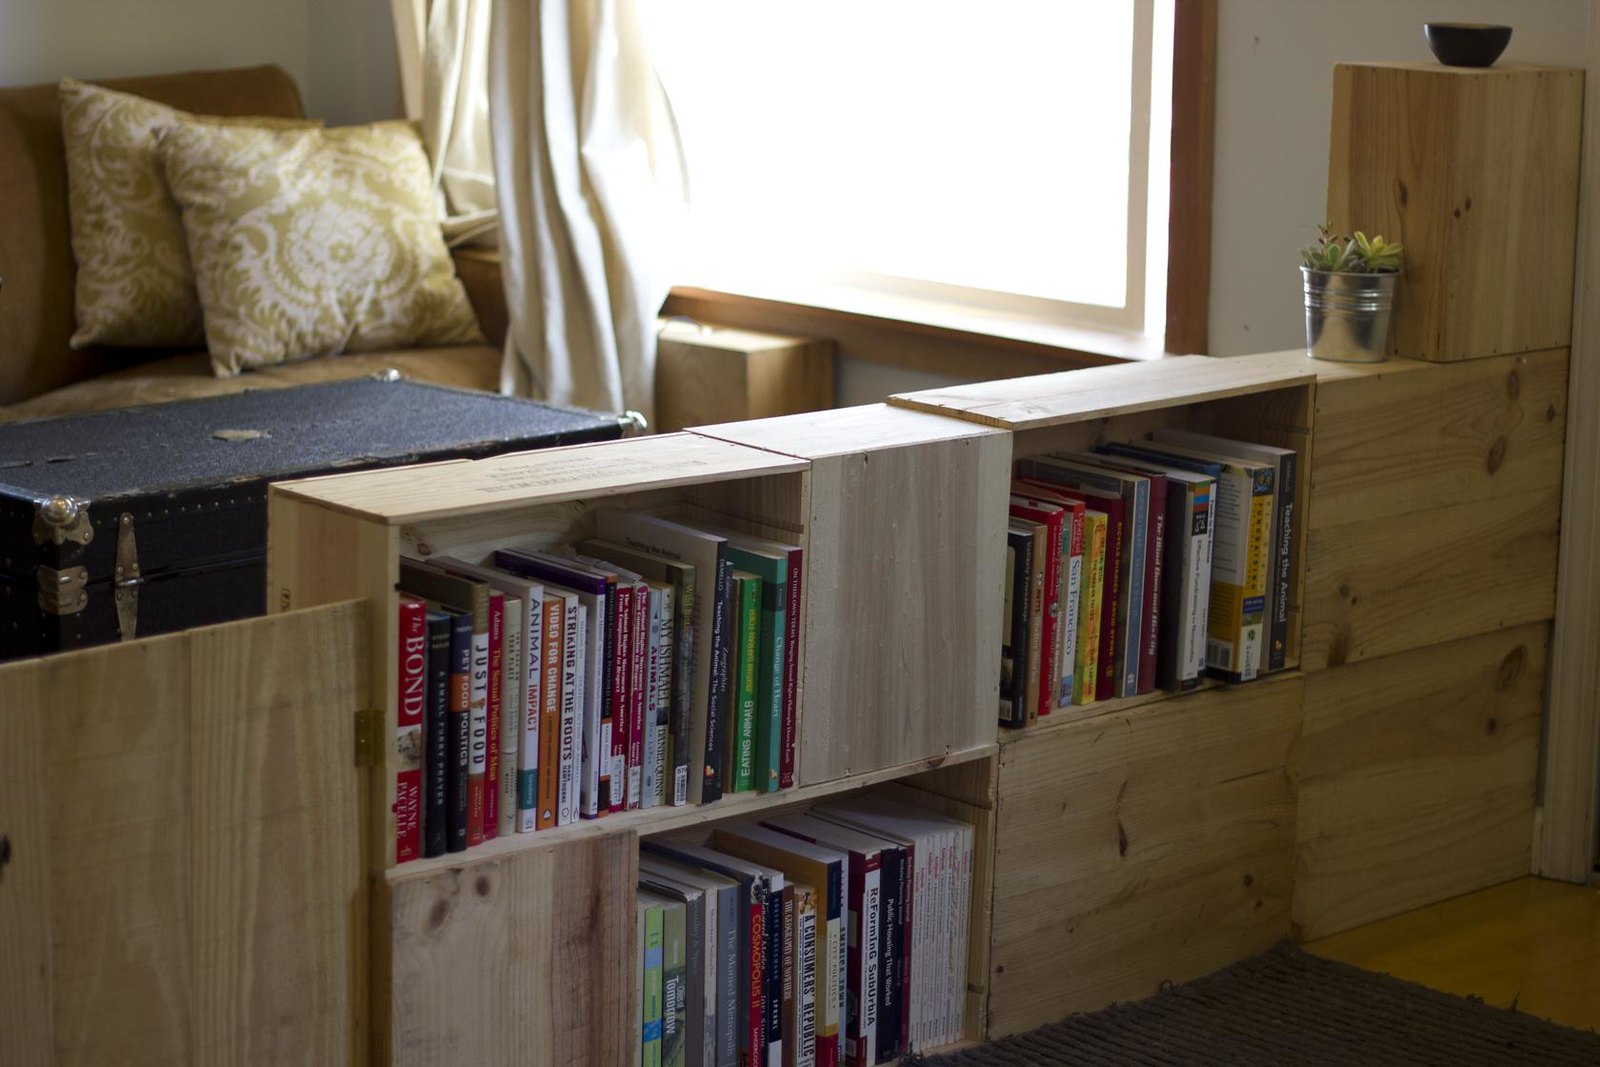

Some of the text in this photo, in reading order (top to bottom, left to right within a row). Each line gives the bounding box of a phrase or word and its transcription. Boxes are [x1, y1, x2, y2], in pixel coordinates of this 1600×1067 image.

[1115, 520, 1123, 558] BICYCLE
[1156, 513, 1164, 535] The
[1279, 503, 1293, 556] Teaching
[1155, 536, 1163, 566] Blind
[1280, 557, 1290, 579] the
[792, 567, 800, 579] ON
[1070, 559, 1080, 586] San
[1192, 573, 1201, 615] Fundraising
[1279, 581, 1289, 623] Animal
[492, 609, 502, 641] Adams
[548, 603, 561, 639] VIDEO
[622, 607, 630, 632] Animal
[714, 600, 724, 635] Teaching
[1065, 590, 1078, 655] Francisco
[461, 648, 471, 672] PET
[491, 647, 502, 669] The
[547, 641, 559, 665] FOR
[621, 633, 629, 657] Rights
[714, 635, 722, 649] the
[1148, 634, 1156, 656] City
[403, 615, 425, 717] The BOND
[527, 598, 541, 733] ANIMAL IMPACT
[562, 606, 578, 761] STRIKING AT THE ROOTS
[620, 658, 628, 695] Movement
[648, 645, 658, 712] ANIMALS
[773, 636, 784, 717] Change of Heart
[437, 681, 446, 717] SMALL
[460, 674, 470, 709] FOOD
[472, 644, 488, 765] JUST FOOD
[490, 670, 501, 702] Sexual
[546, 667, 557, 714] CHANGE
[711, 680, 719, 694] The
[488, 703, 500, 742] Politics
[618, 704, 626, 734] America
[655, 617, 673, 798] MY ISHMAEL DANIEL QUINN
[709, 695, 718, 719] Social
[437, 721, 445, 758] FURRY
[459, 711, 469, 767] POLITICS
[488, 743, 499, 756] of
[707, 719, 716, 752] Sciences
[740, 700, 754, 777] EATING ANIMALS
[435, 762, 445, 806] PRAYER
[488, 756, 499, 782] Meat
[397, 781, 409, 840] PACELLE
[407, 784, 418, 832] WAYNE
[804, 914, 815, 923] A
[727, 928, 738, 951] The
[751, 914, 762, 997] COSMOPOLIS
[783, 900, 793, 1001] THE GEOGRAPHY OF NOWHERE
[884, 898, 895, 1007] Public Housing That Worked
[726, 953, 737, 996] Monied
[665, 975, 680, 1034] Tomorrow
[725, 999, 737, 1057] Metropolis
[802, 1003, 815, 1058] REPUBLIC
